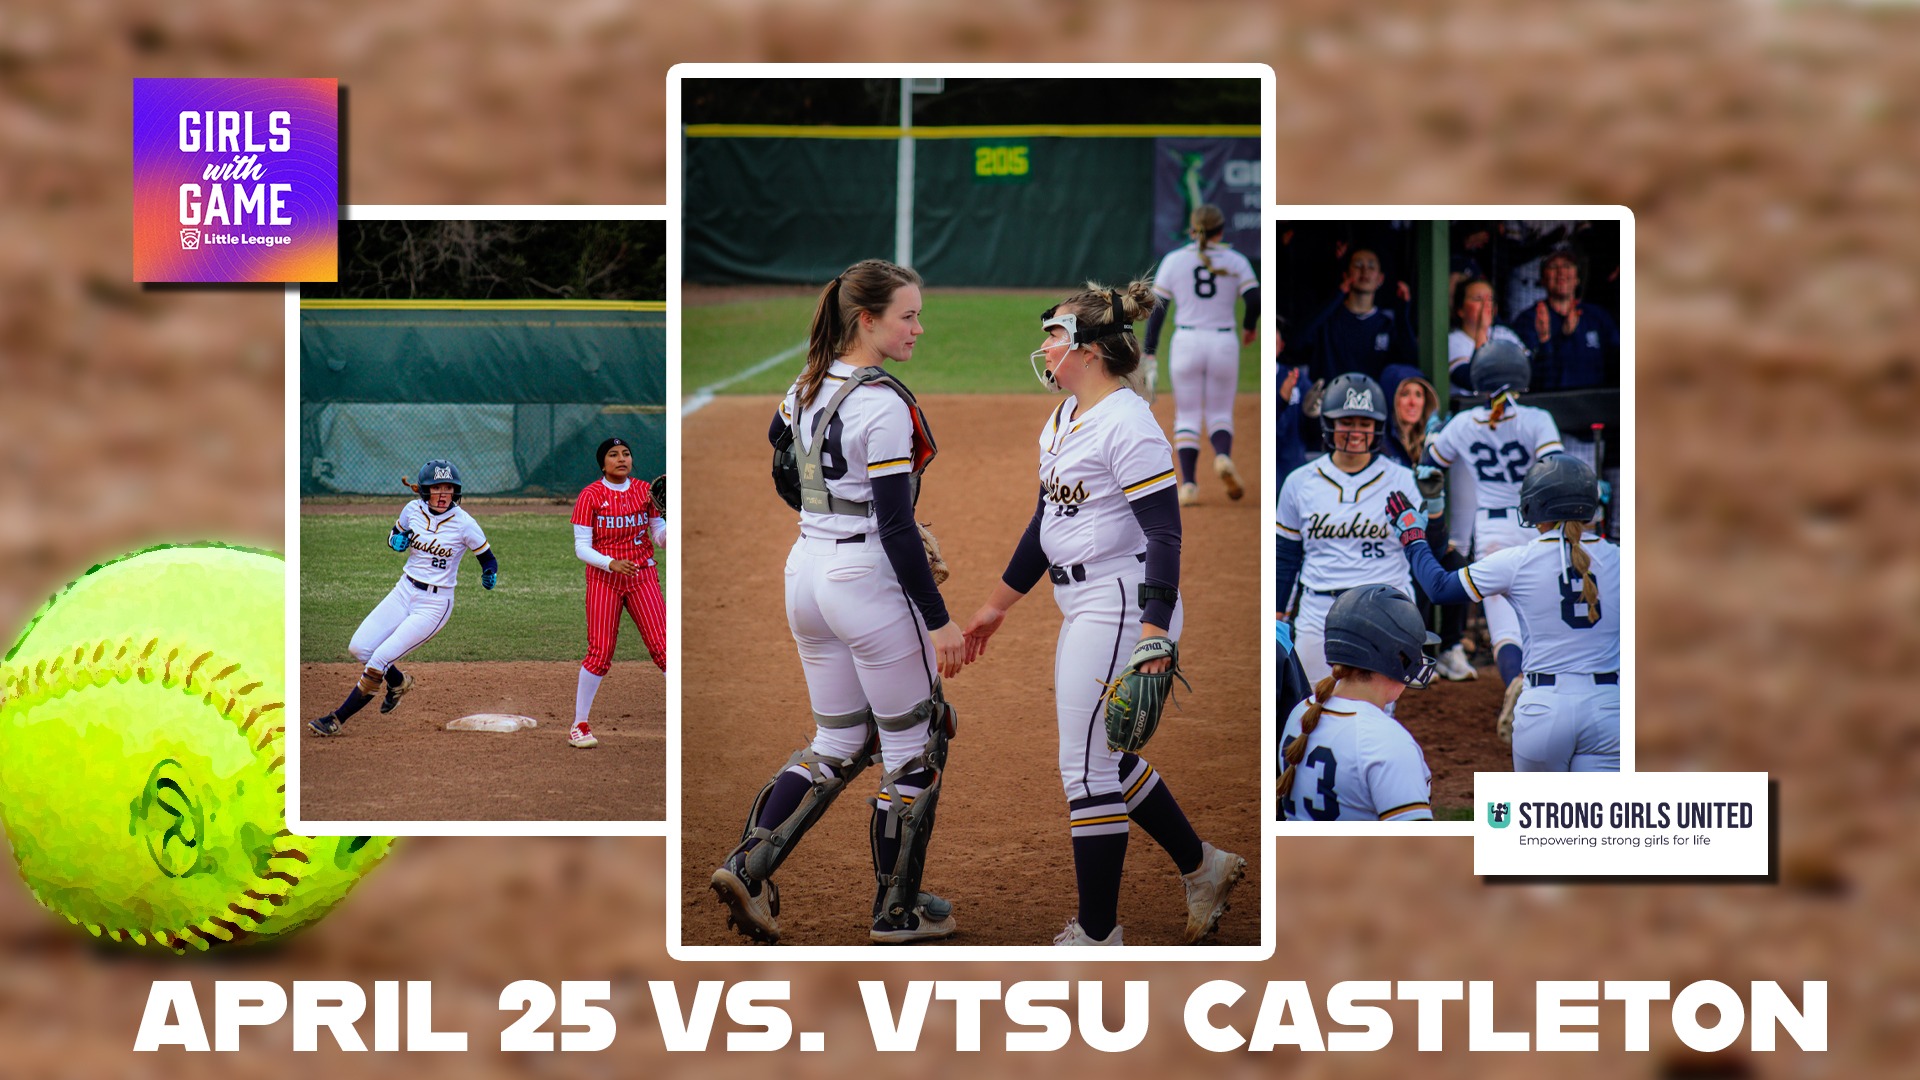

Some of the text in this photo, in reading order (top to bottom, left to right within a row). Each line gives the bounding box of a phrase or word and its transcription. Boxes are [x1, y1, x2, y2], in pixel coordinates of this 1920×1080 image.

[975, 146, 1029, 176] 205
[1193, 265, 1217, 299] 8
[1469, 440, 1531, 482] 22
[597, 511, 649, 529] THOMAS
[1307, 511, 1391, 540] Huskies
[409, 530, 454, 558] Huskies
[1361, 542, 1387, 559] 25
[431, 557, 447, 570] 22
[1558, 566, 1602, 630] 8
